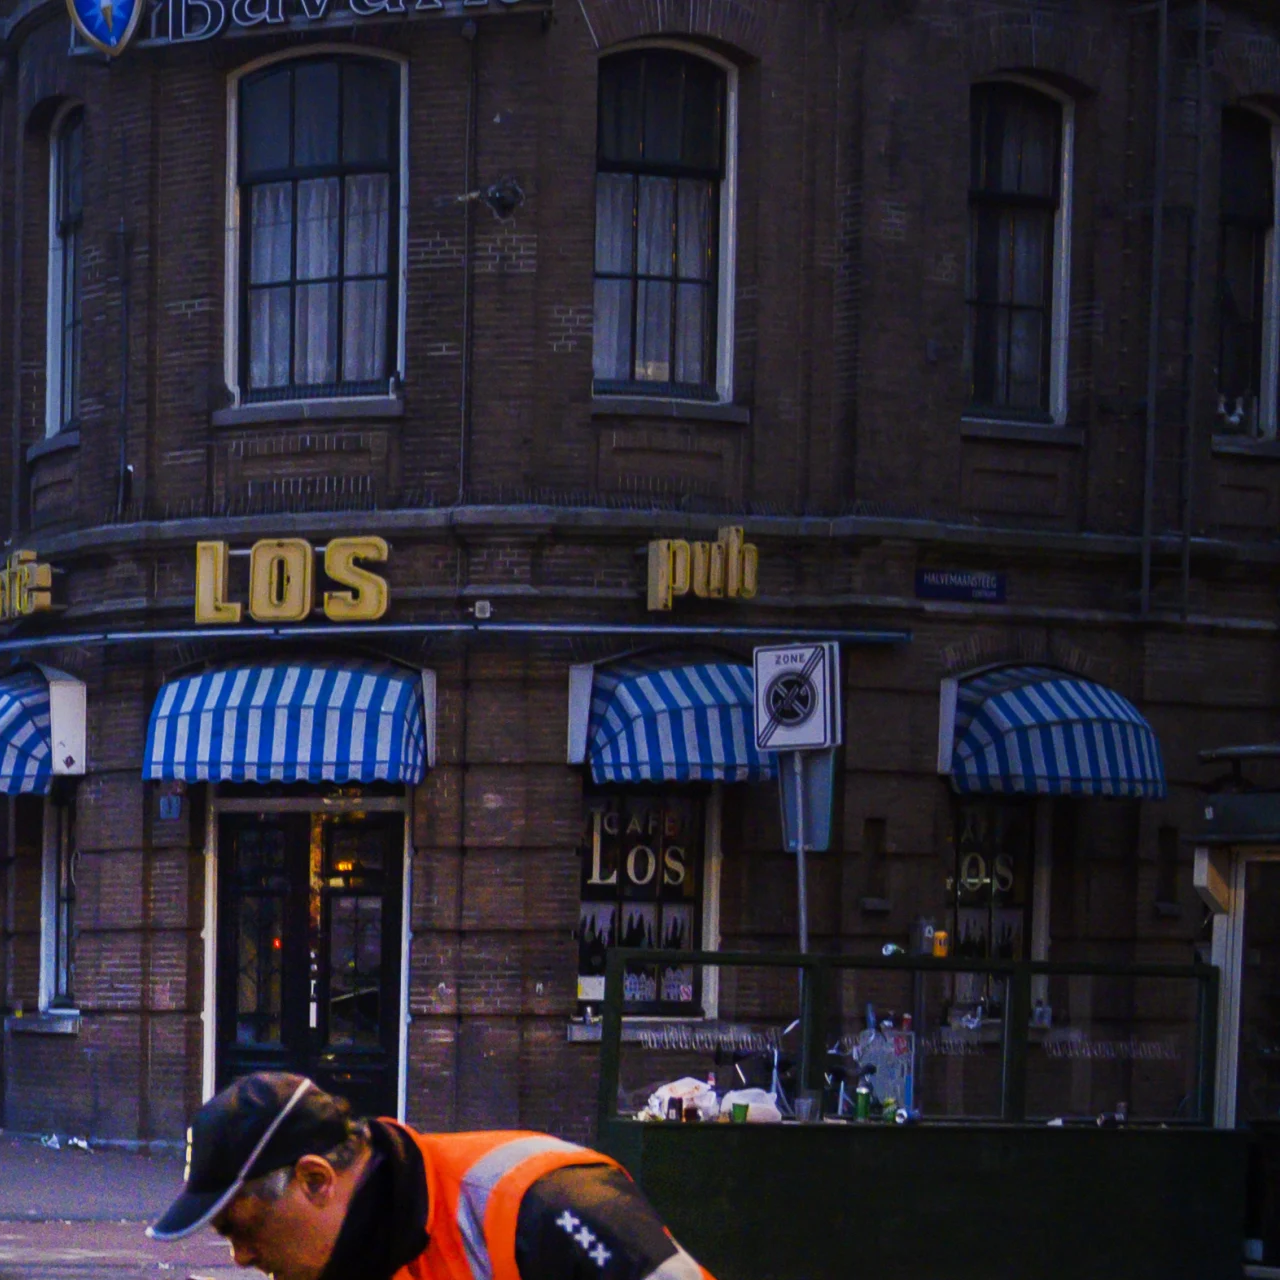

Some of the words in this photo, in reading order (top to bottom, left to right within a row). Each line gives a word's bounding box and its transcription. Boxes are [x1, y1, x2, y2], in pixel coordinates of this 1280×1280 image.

[195, 536, 389, 624] LOS
[647, 525, 758, 611] pub
[774, 653, 806, 664] ZONE
[587, 808, 686, 885] LOS
